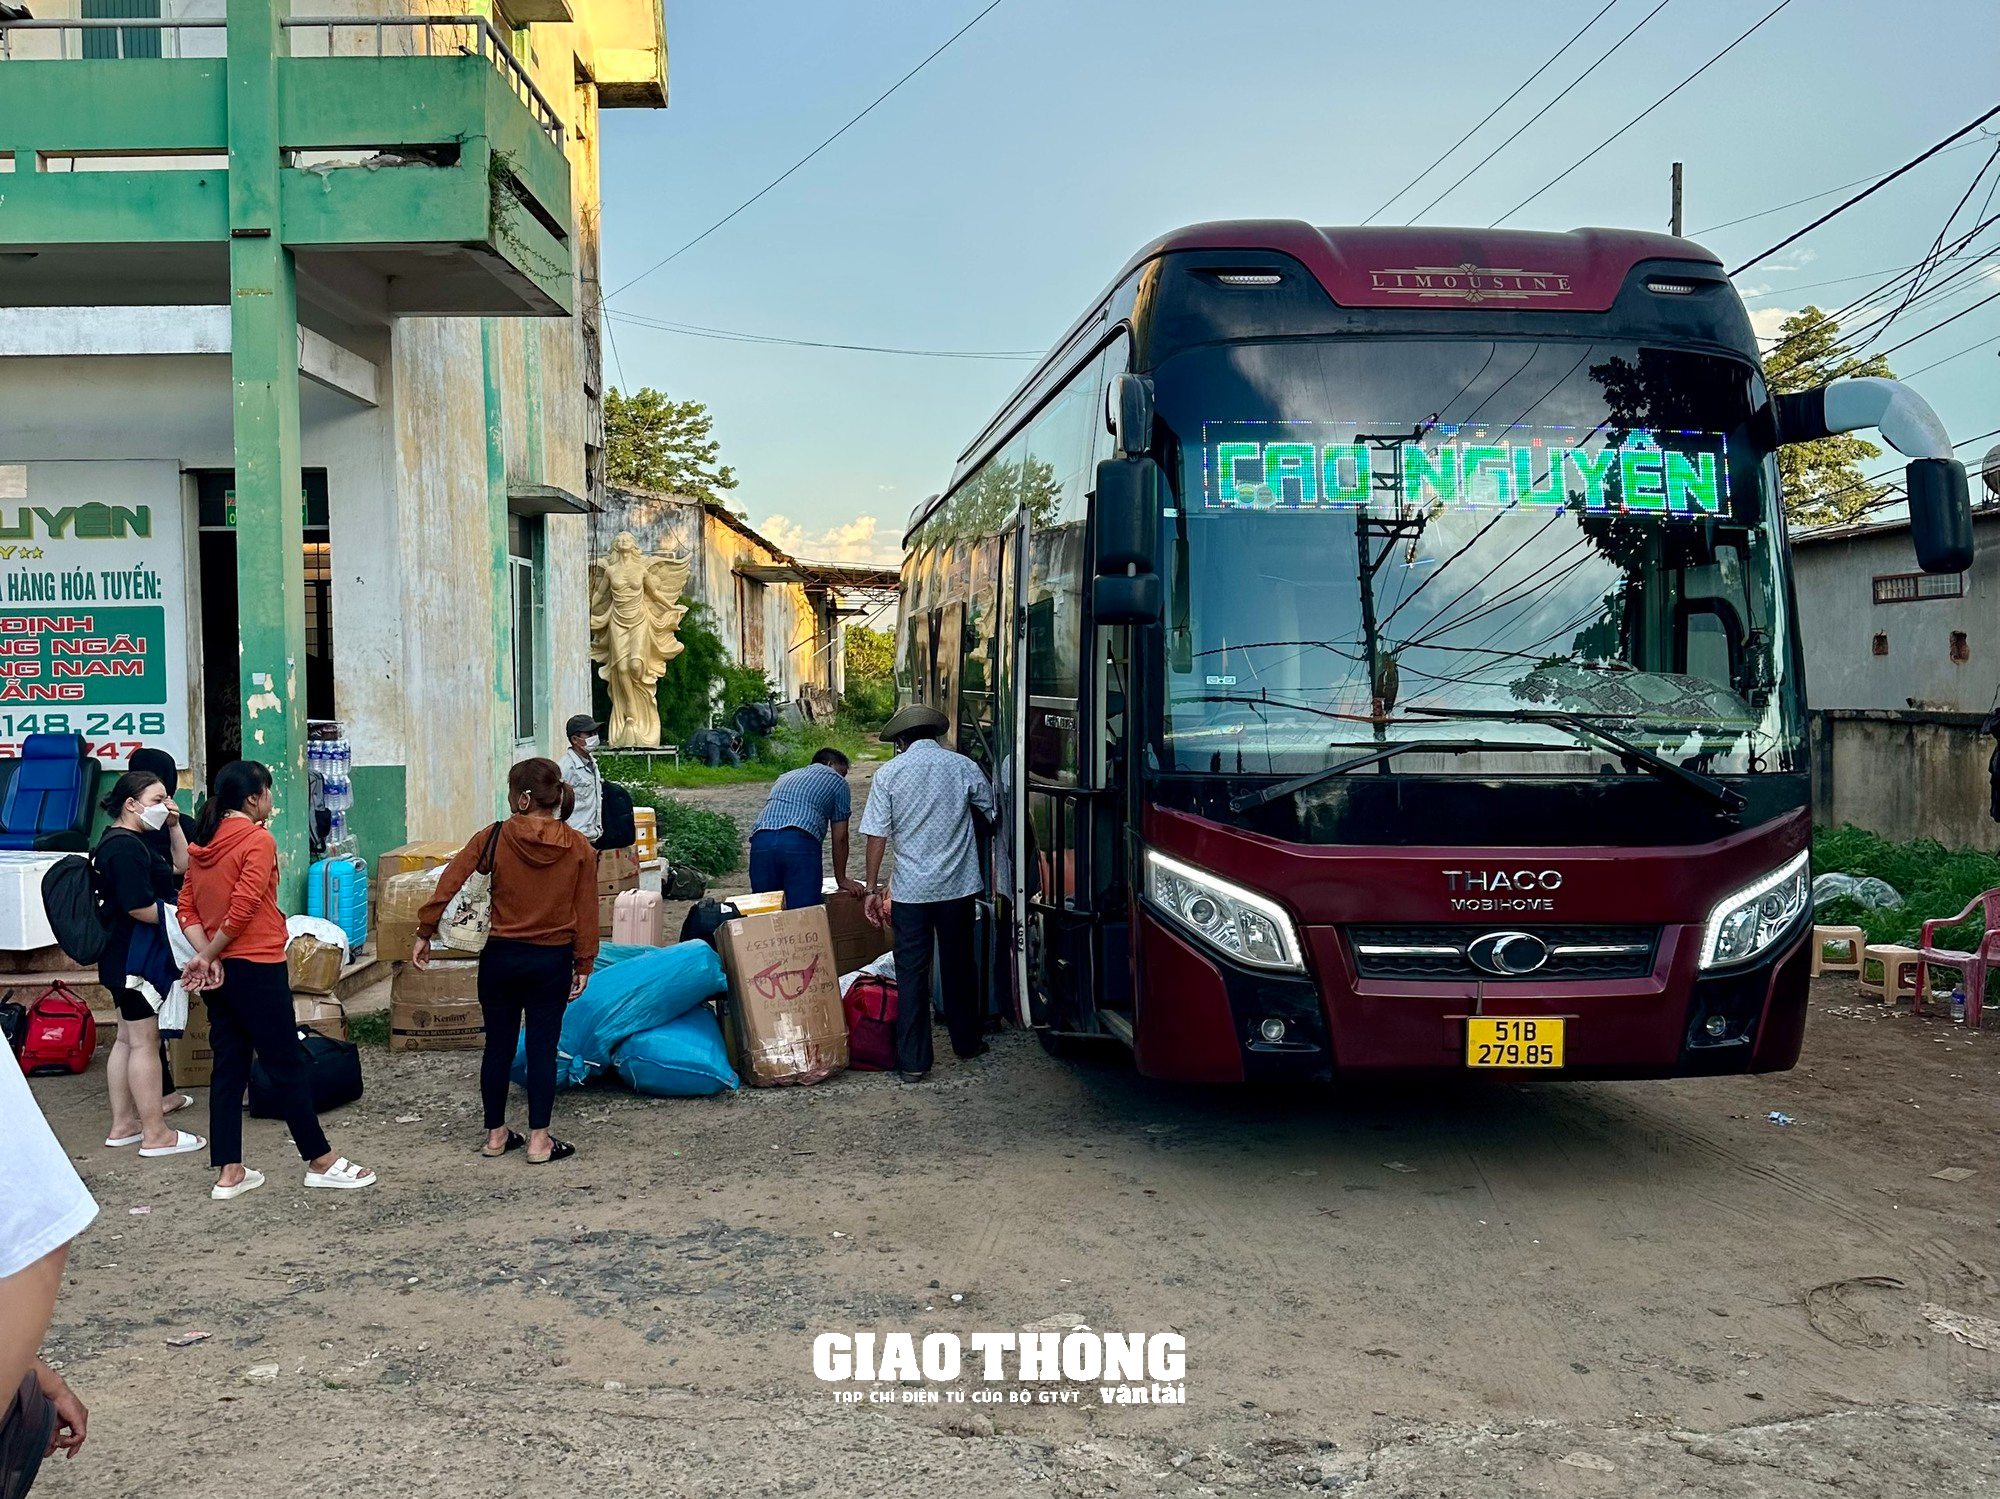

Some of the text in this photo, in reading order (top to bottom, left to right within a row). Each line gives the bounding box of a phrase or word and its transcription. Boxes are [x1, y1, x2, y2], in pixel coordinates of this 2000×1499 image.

[1372, 274, 1571, 290] LIMOUSINE
[1217, 428, 1720, 513] CAO NGUYÊN
[8, 561, 162, 601] HÀNG HÓA TUYẾN:
[0, 616, 94, 636] ĐỊNH
[51, 634, 147, 655] NGÃI
[52, 659, 145, 677] NAM
[0, 712, 166, 736] 148.248
[1442, 870, 1563, 892] THACO
[1451, 899, 1554, 911] MOBIHOME
[1495, 1021, 1537, 1042] 51B
[1478, 1044, 1554, 1065] 279.85
